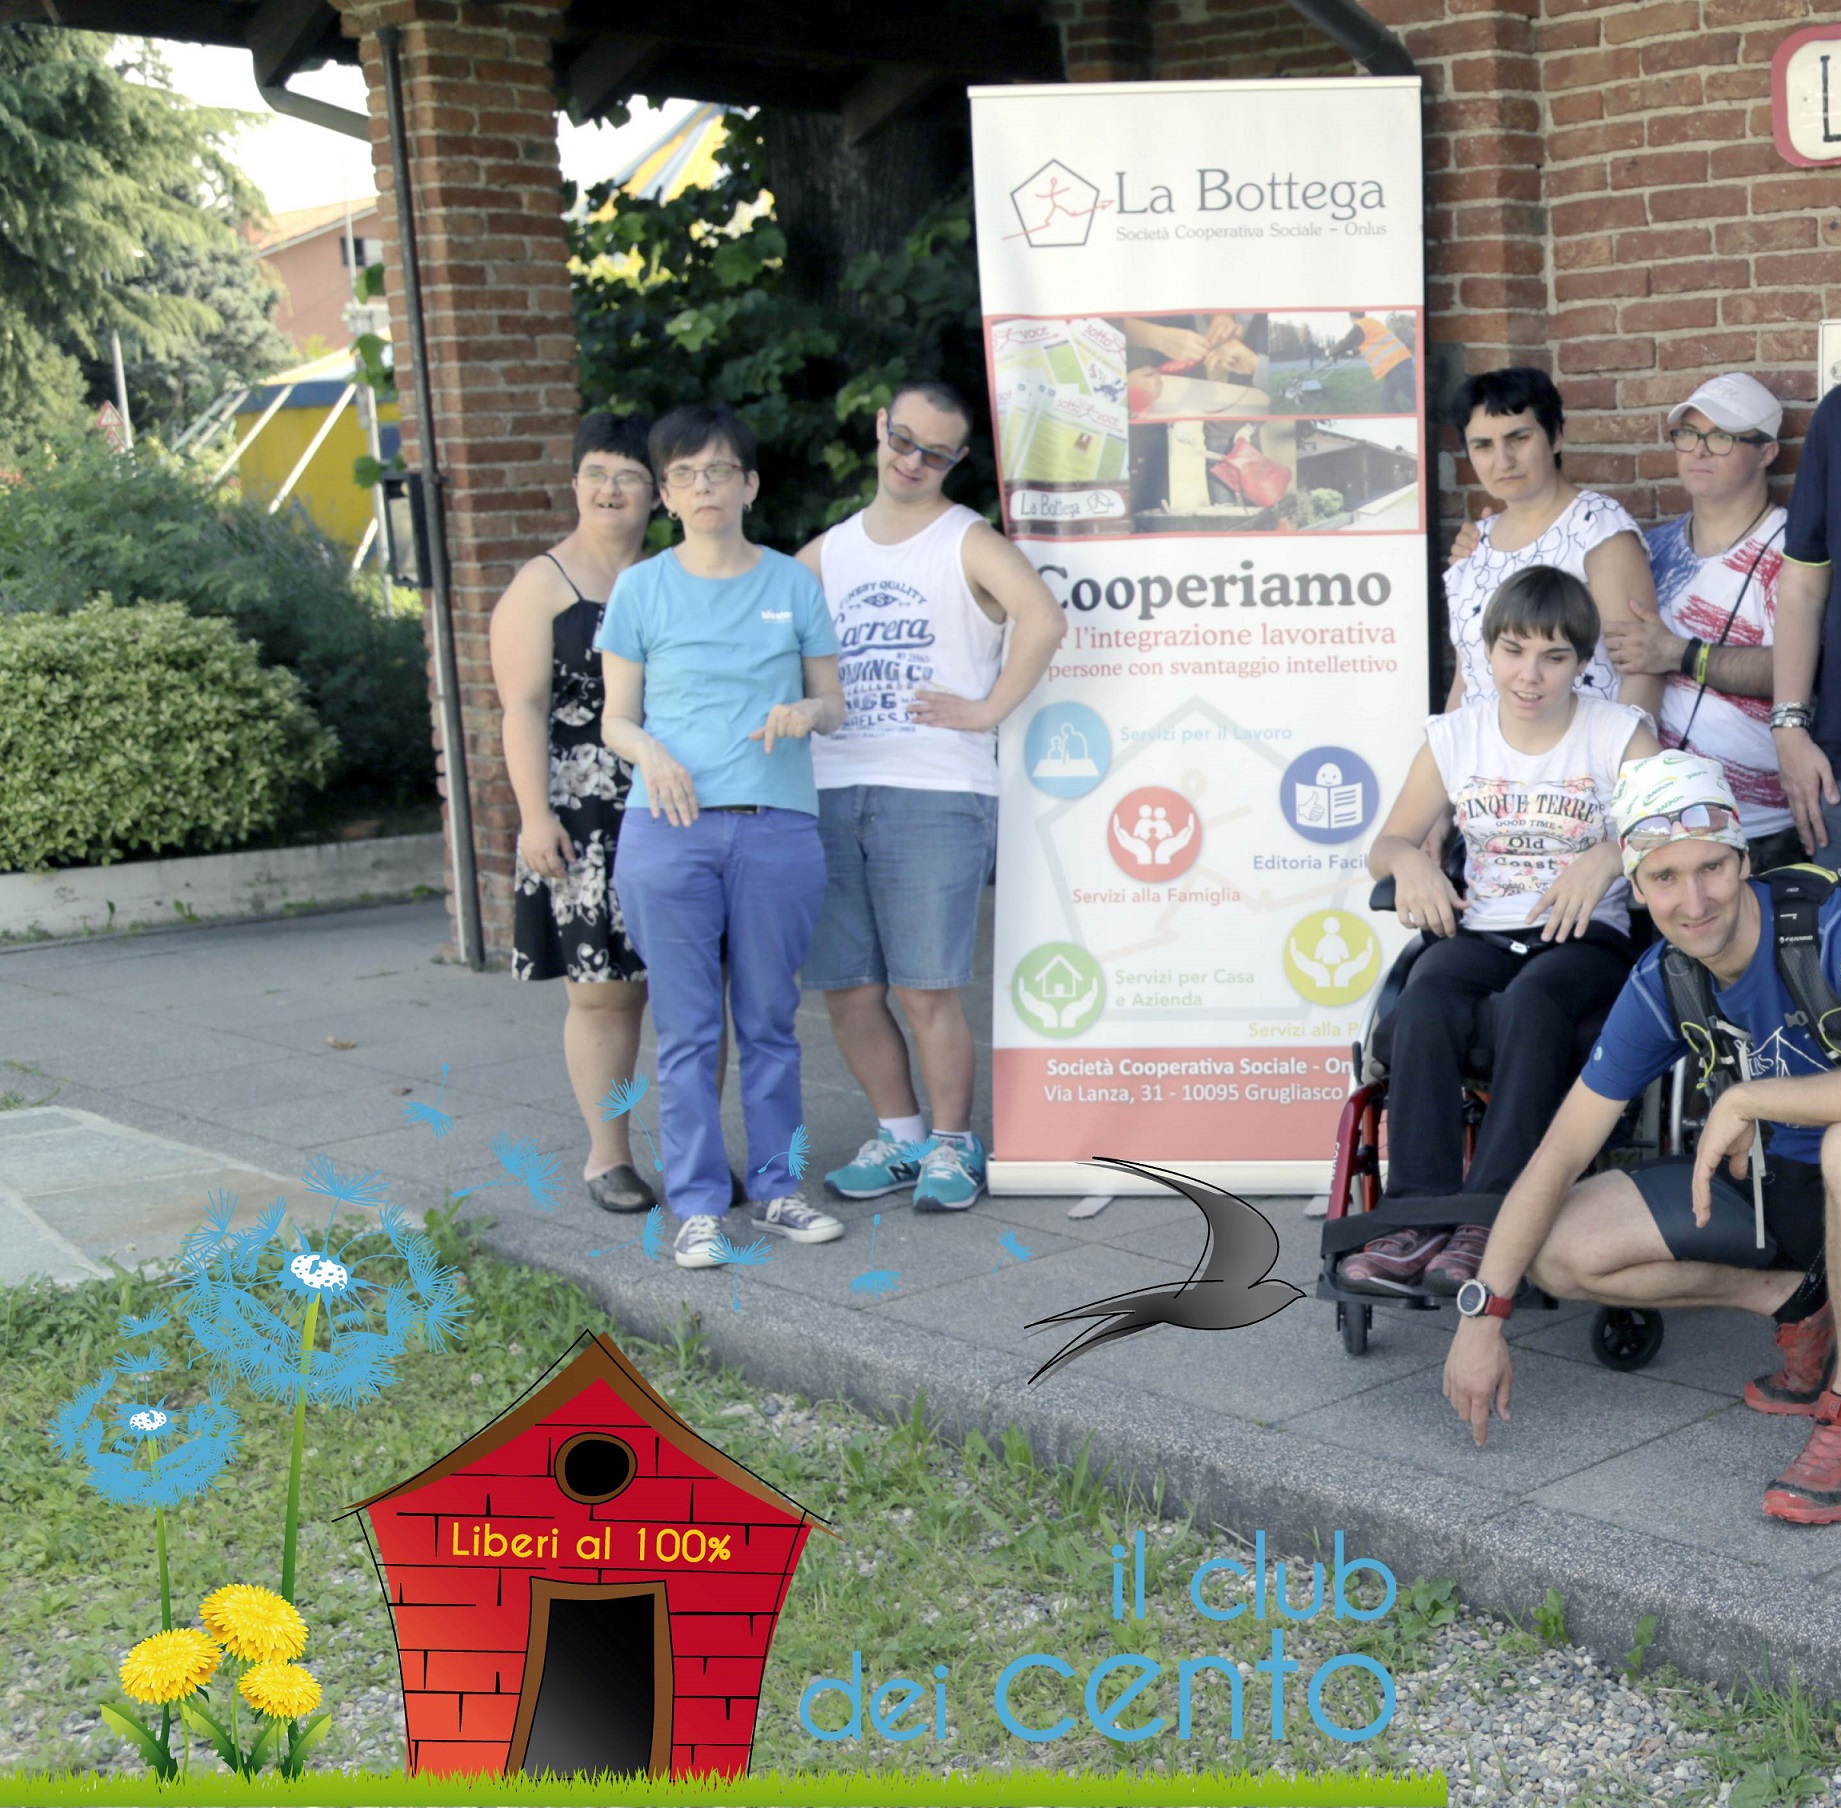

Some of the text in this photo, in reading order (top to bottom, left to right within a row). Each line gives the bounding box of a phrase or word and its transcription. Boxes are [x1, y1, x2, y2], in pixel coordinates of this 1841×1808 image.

[1115, 168, 1386, 220] La Bottega
[1116, 224, 1170, 241] Società
[1175, 222, 1264, 241] Cooperativa
[1270, 222, 1322, 237] Sociale
[1345, 221, 1388, 236] Onlus
[1021, 492, 1080, 519] La Bottega
[834, 612, 933, 654] Carrera
[1261, 622, 1396, 647] lavorativa
[1048, 655, 1397, 682] persone con svantaggio intellettivo
[1120, 725, 1293, 744] Servizi per il Lavoro
[1466, 794, 1528, 819] INQUE
[1536, 794, 1598, 824] TERRE
[1509, 837, 1544, 849] Old
[1253, 854, 1369, 871] Editoria Facil
[1494, 857, 1557, 870] Coast
[1072, 888, 1241, 907] Servizi alla Famiglia
[1115, 969, 1254, 988] Servizi per Casa
[1115, 992, 1203, 1008] e Azienda
[1248, 1023, 1306, 1038] Servizi
[1311, 1022, 1341, 1037] alla
[1046, 1058, 1114, 1076] Società
[1119, 1058, 1234, 1080] Cooperativa
[1239, 1058, 1307, 1075] Sociale
[1044, 1084, 1075, 1102] Via
[1078, 1085, 1134, 1105] Lanza,
[1140, 1085, 1164, 1101] 31
[1181, 1084, 1239, 1101] 10095
[1244, 1083, 1343, 1106] Grugliasco
